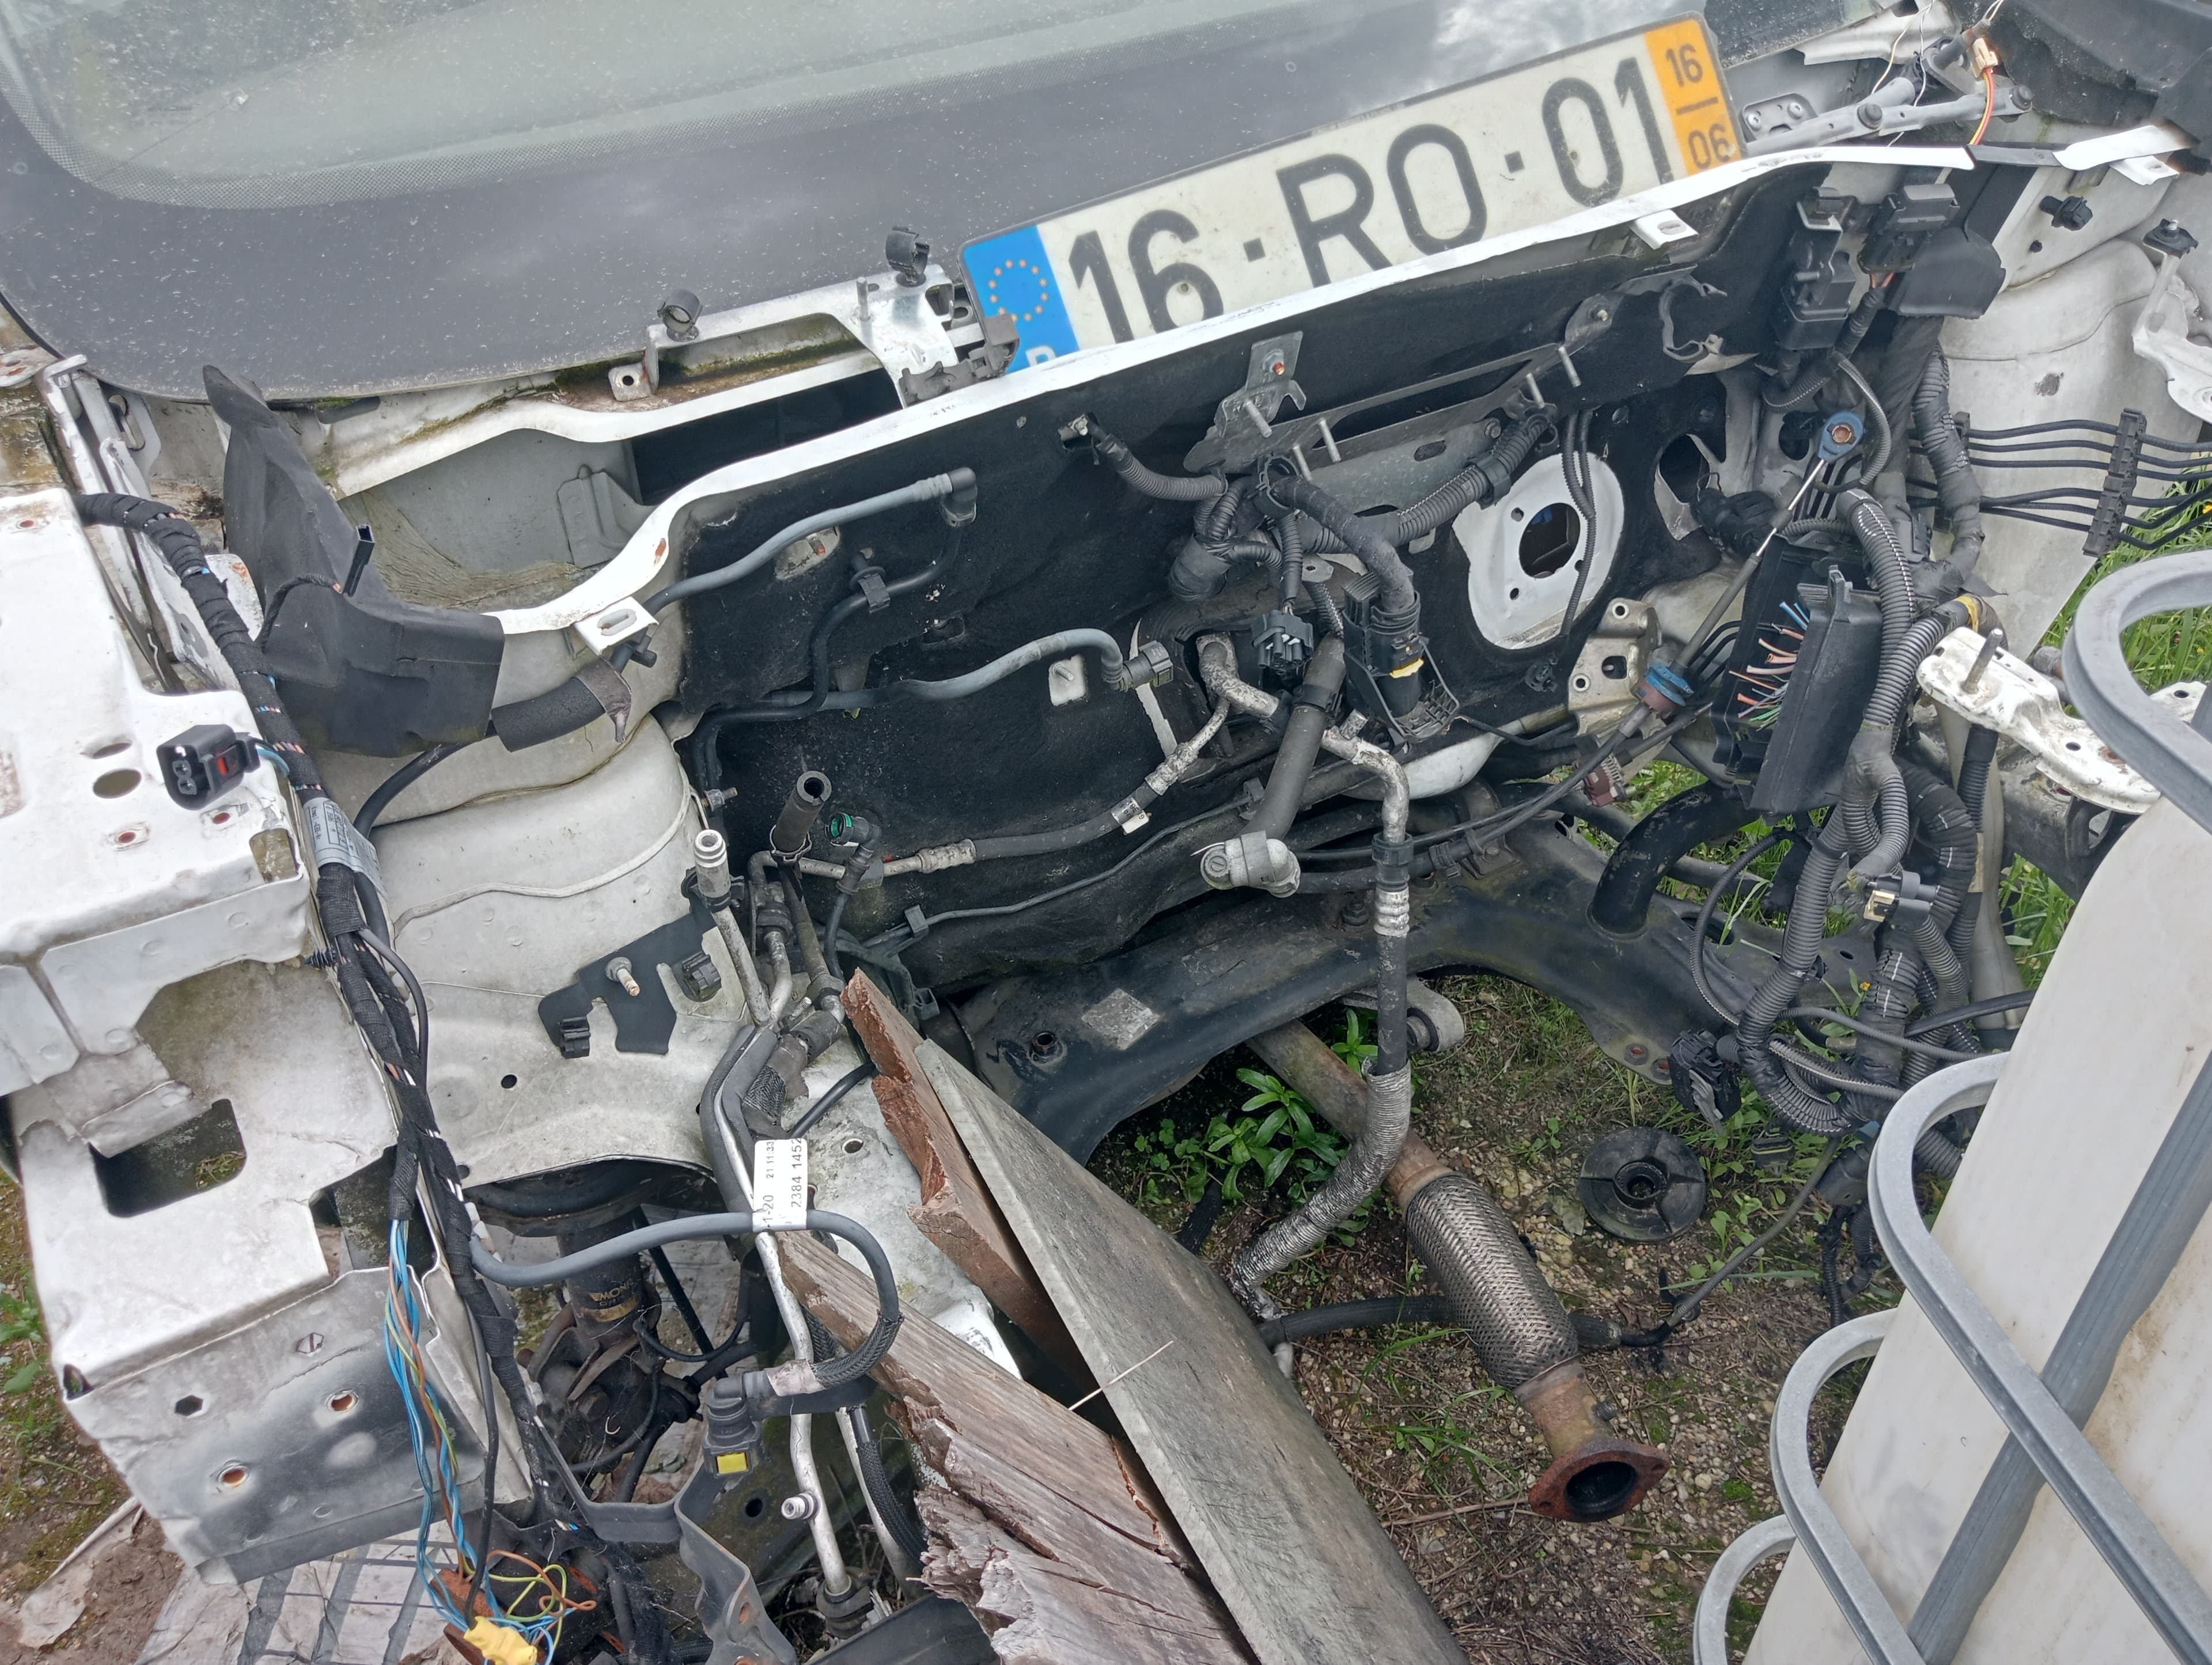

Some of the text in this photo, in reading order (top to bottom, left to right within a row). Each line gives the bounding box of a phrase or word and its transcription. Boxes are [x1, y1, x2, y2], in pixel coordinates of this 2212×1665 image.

[1665, 43, 1703, 88] 16
[1688, 123, 1730, 170] 06
[791, 1175, 802, 1207] 2384
